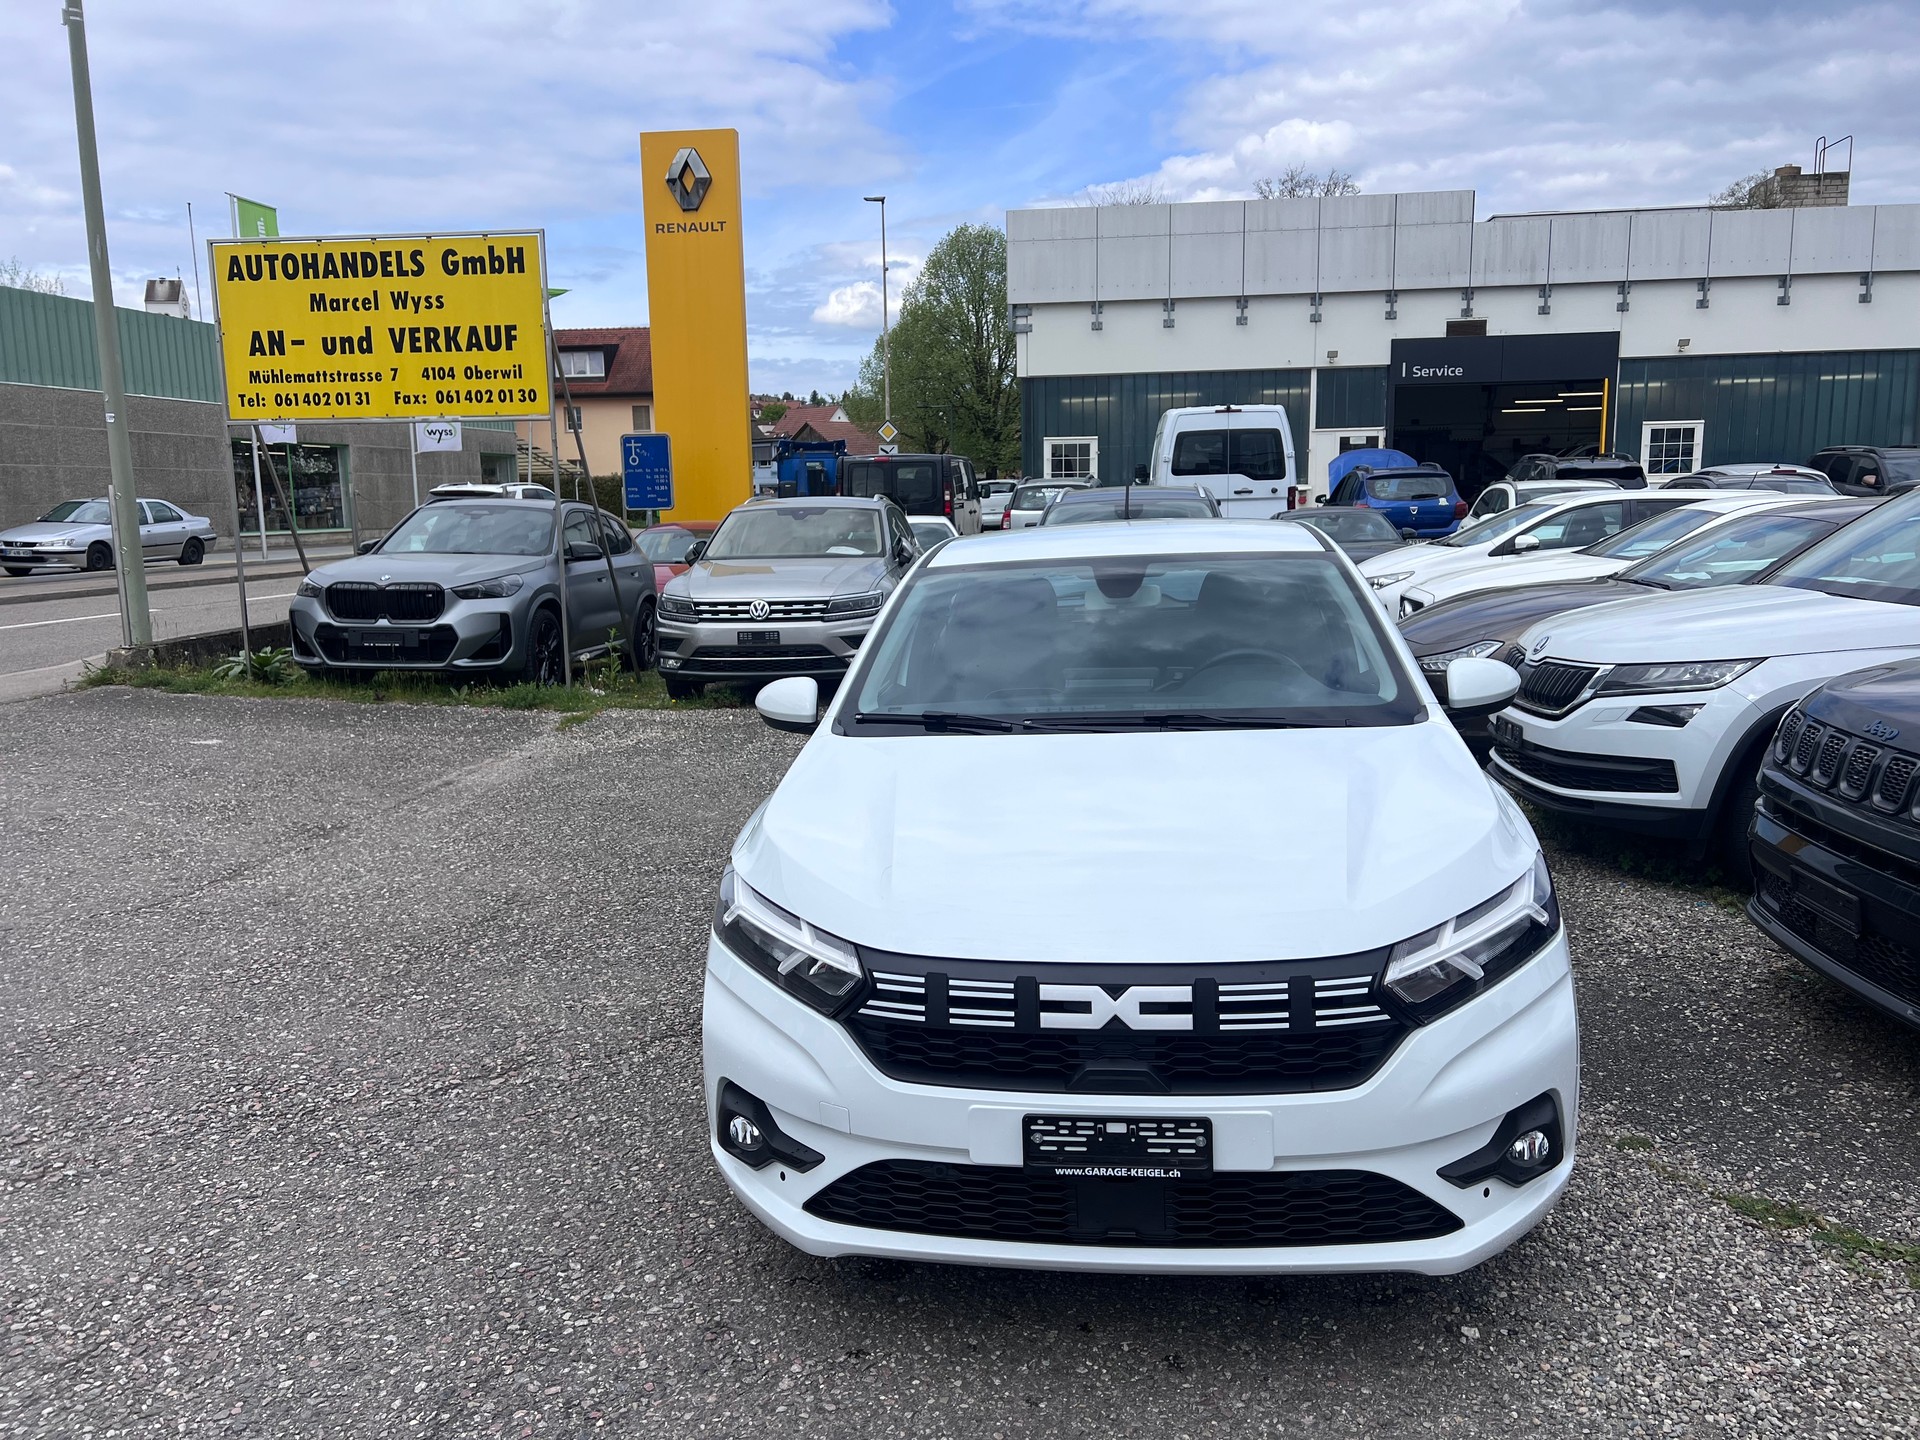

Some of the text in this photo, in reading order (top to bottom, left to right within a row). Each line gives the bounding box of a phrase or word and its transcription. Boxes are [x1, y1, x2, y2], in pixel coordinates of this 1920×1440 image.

[655, 221, 727, 234] RENAULT
[227, 245, 526, 281] AUTOHANDELS GmbH
[309, 290, 445, 314] Marcel Wyss
[321, 325, 374, 356] und
[387, 324, 518, 354] VERKAUF
[249, 364, 523, 385] Mühlemattstrasse 7 4104 Oberwil
[1412, 364, 1464, 378] Service
[237, 392, 267, 408] Tel:
[394, 390, 427, 405] Fax:
[426, 429, 454, 444] wyss
[1864, 720, 1899, 742] Jeep
[1055, 1167, 1181, 1177] www.GARAGE-KEIGEL.ch
